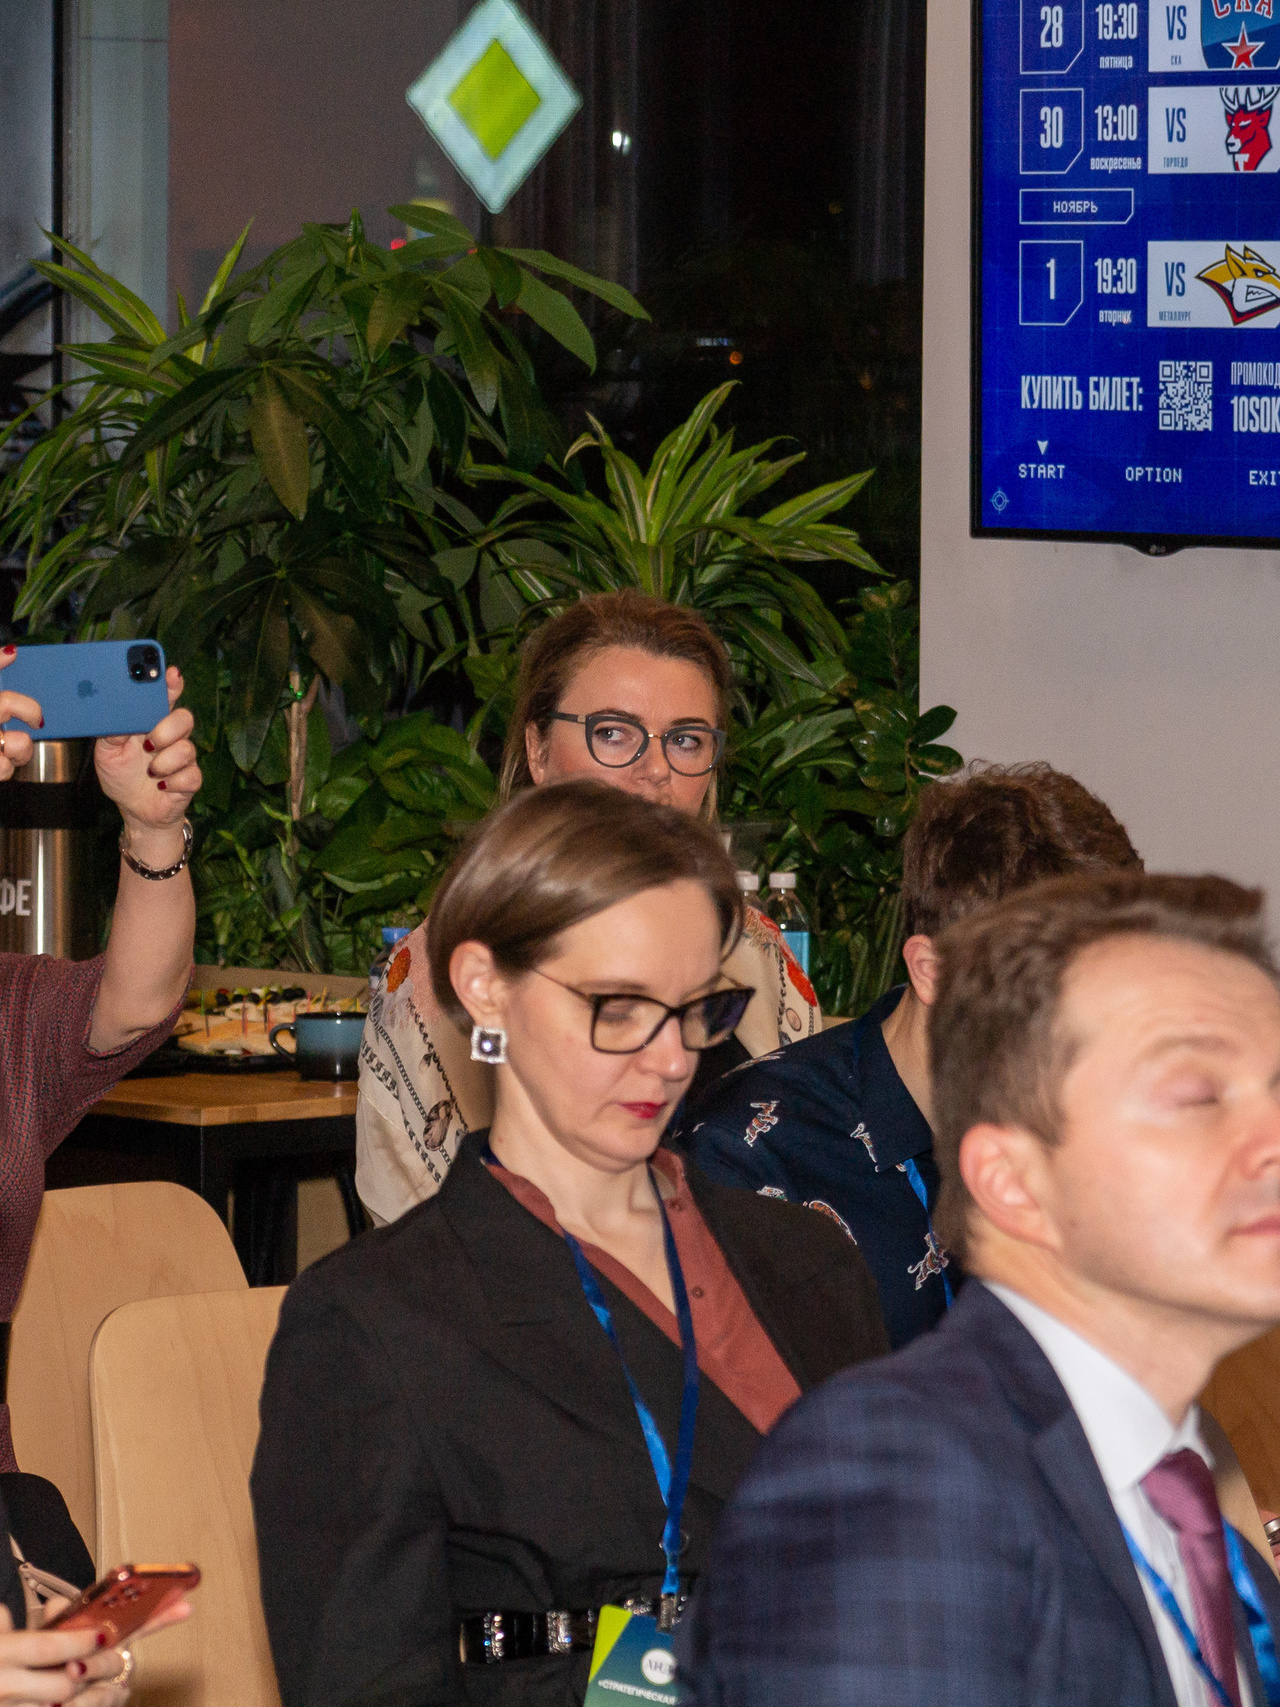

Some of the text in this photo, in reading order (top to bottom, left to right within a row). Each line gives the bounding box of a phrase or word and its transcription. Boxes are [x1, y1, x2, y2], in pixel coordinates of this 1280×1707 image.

[1040, 6, 1063, 48] 28
[1095, 3, 1138, 40] 19:30
[1166, 5, 1187, 41] VS
[1099, 56, 1133, 70] пятница
[1171, 55, 1182, 65] СКА
[1040, 107, 1063, 148] 30
[1094, 104, 1138, 141] 13:00
[1165, 108, 1187, 143] VS
[1090, 157, 1141, 173] воскресенье
[1163, 157, 1189, 168] ТОРПЕДО
[1053, 201, 1098, 213] НОЯБРЬ
[1046, 258, 1056, 300] 1
[1094, 257, 1137, 295] 19:30
[1164, 262, 1186, 297] VS
[1099, 310, 1132, 326] вторник
[1021, 375, 1144, 411] КУПИТЬ БИЛЕТ:
[1018, 464, 1065, 479] START
[1125, 467, 1182, 483] OPTION
